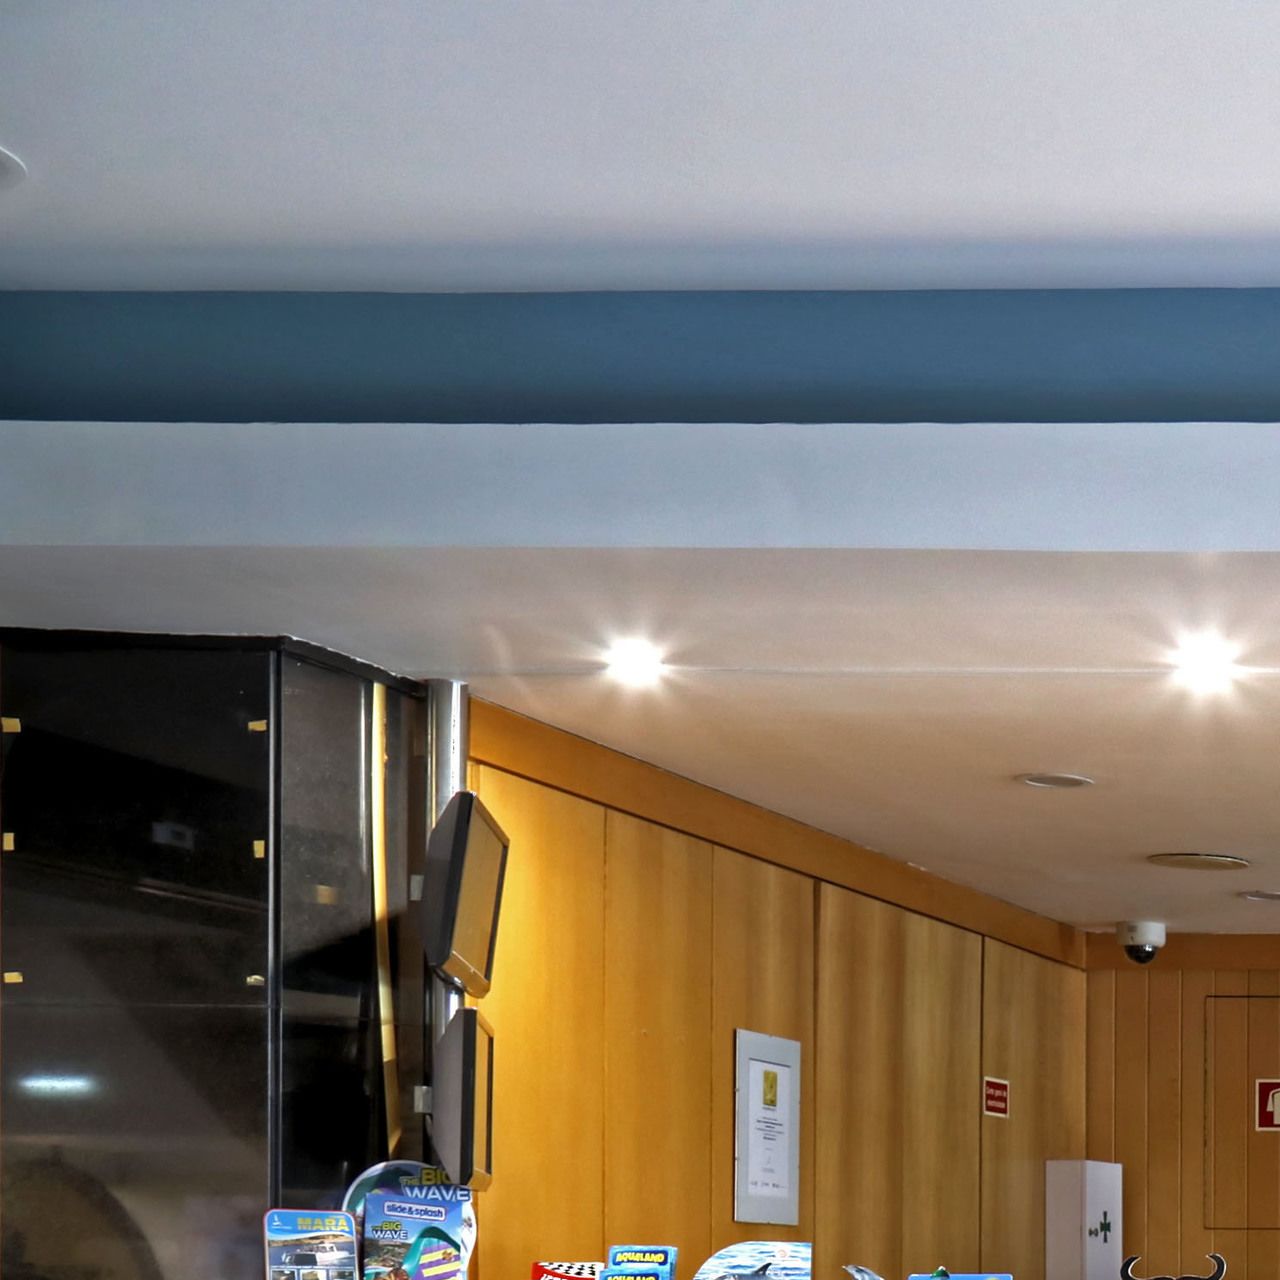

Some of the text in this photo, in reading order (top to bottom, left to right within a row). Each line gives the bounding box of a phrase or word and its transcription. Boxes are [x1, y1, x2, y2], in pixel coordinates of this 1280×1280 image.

[405, 1186, 470, 1201] WAVE
[297, 1217, 350, 1232] MARA
[382, 1221, 402, 1230] BIG
[373, 1229, 408, 1240] WAVE
[616, 1252, 665, 1263] AQUALAND
